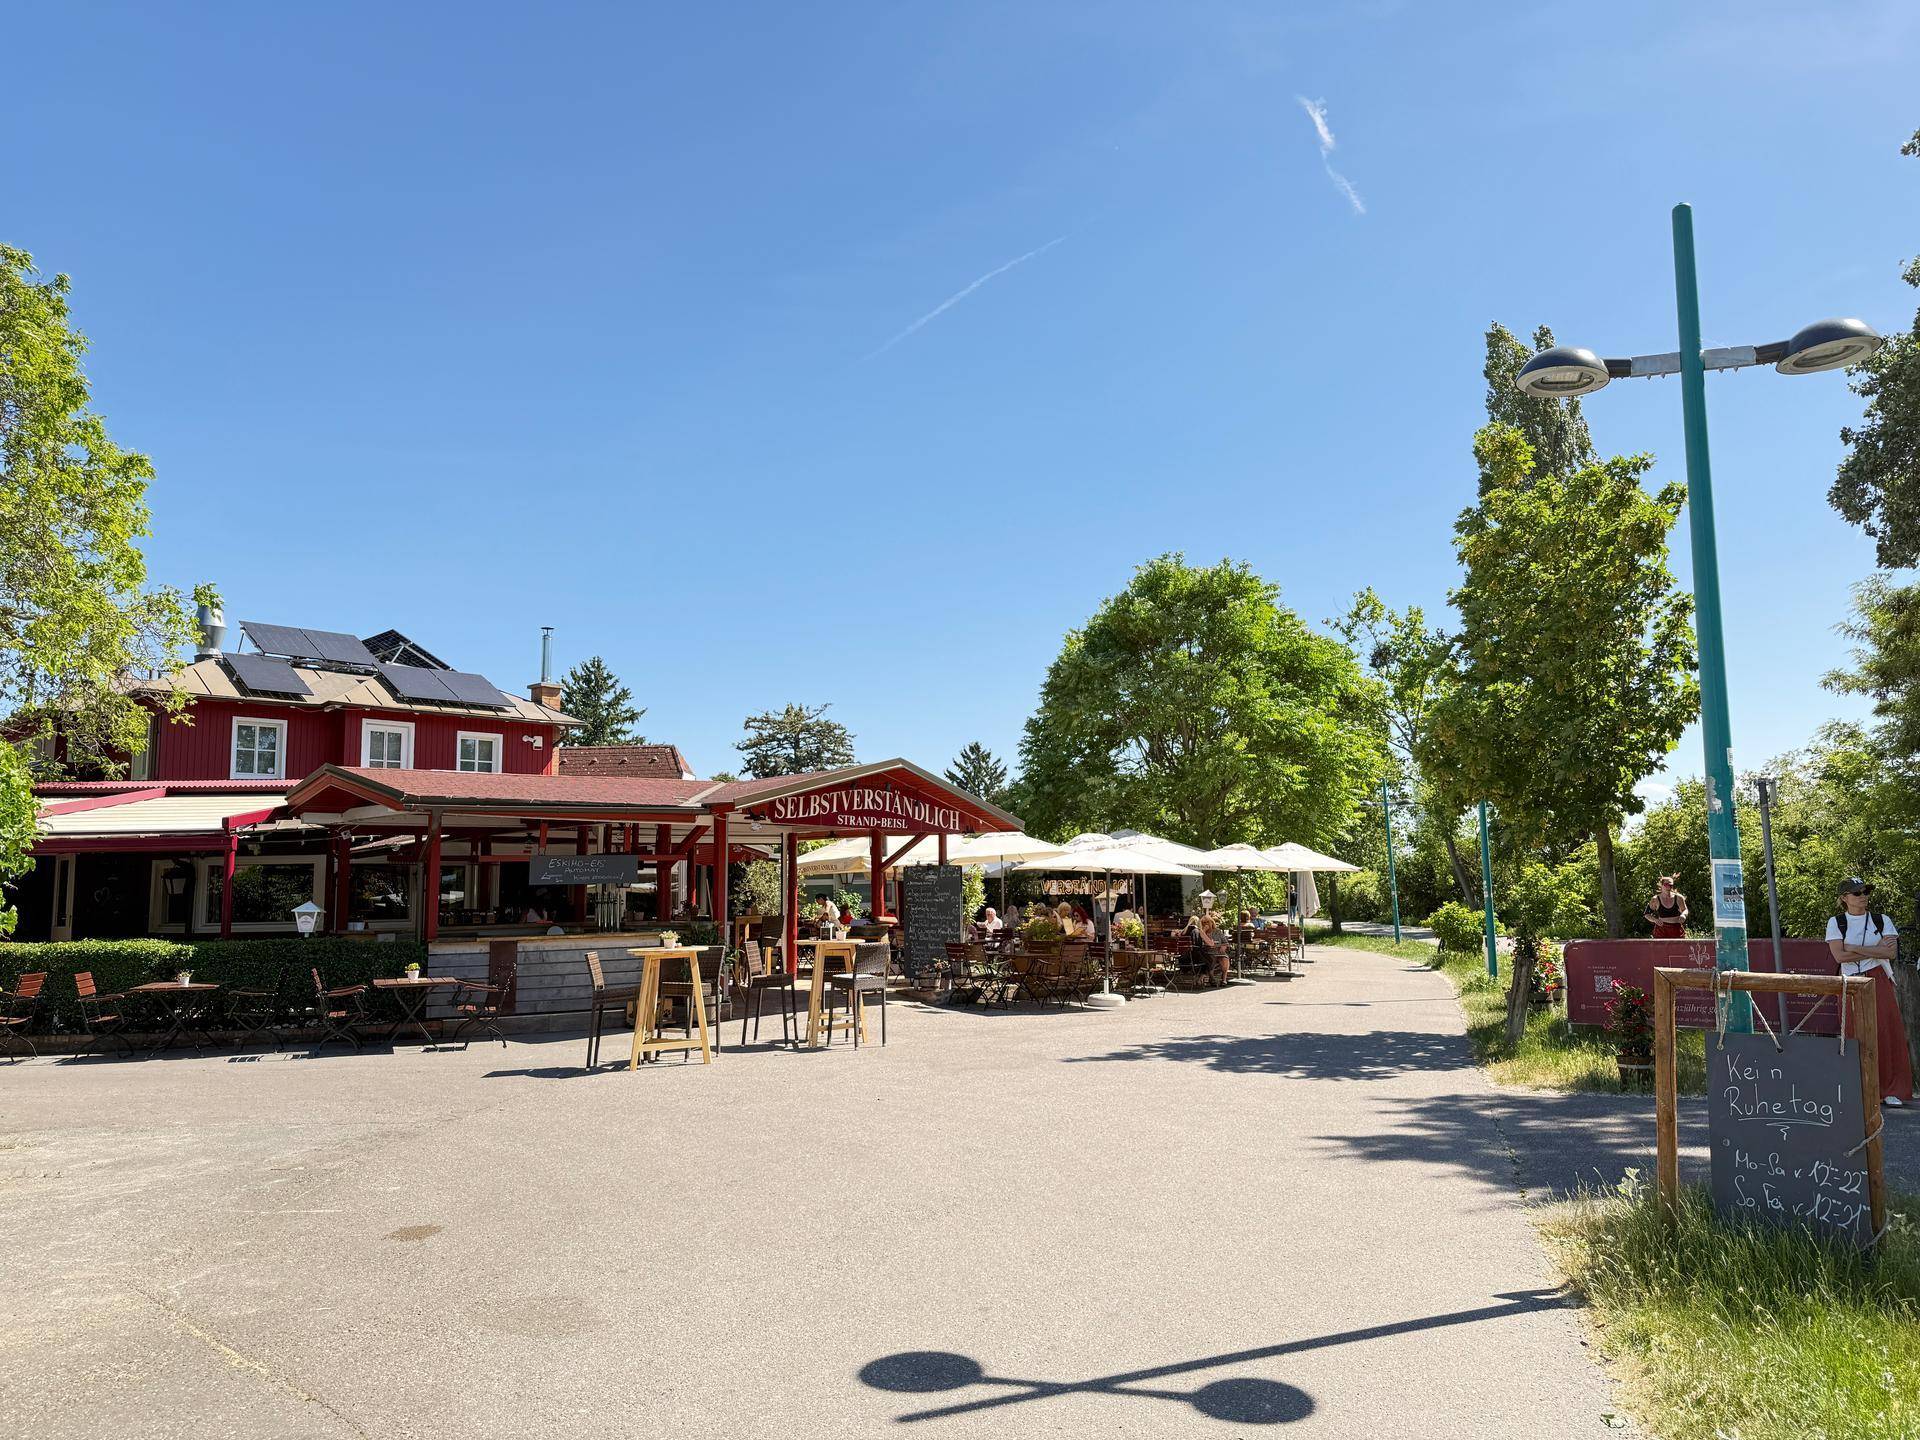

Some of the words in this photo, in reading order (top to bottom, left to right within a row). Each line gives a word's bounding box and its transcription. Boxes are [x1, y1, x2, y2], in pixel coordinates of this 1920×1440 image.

[774, 788, 960, 831] SELBSTVERSTÄNDLICH
[837, 814, 908, 829] STRAND-BEISL
[1727, 1052, 1782, 1082] Kein
[1735, 1149, 1786, 1177] Mo-Sa
